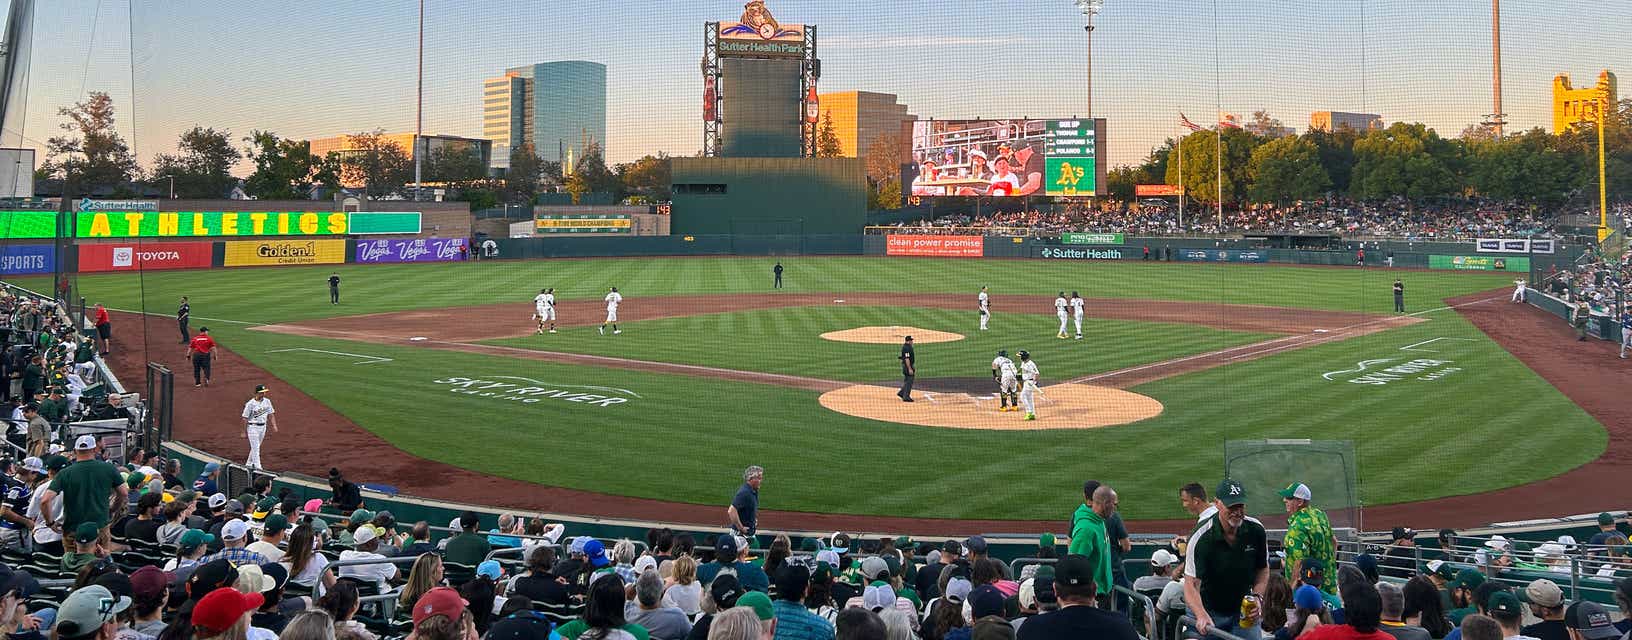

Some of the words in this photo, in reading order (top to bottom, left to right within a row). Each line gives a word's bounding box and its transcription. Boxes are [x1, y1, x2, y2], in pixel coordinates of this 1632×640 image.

[719, 41, 749, 51] Sutter
[751, 42, 780, 52] Health
[782, 44, 803, 53] Park
[94, 200, 125, 209] Sutter
[126, 200, 157, 209] Health
[89, 212, 347, 237] ATHLETICS
[433, 241, 461, 258] Vega
[889, 237, 912, 246] clean
[913, 239, 941, 248] power
[944, 240, 980, 248] promise
[136, 251, 180, 261] TOYOTA
[357, 241, 394, 261] Vegas
[396, 241, 431, 260] Vegas
[1053, 248, 1086, 259] Sutter
[1087, 249, 1121, 259] Health
[1, 255, 44, 270] SPORTS
[433, 377, 517, 389] SKY
[505, 386, 628, 407] RIVER
